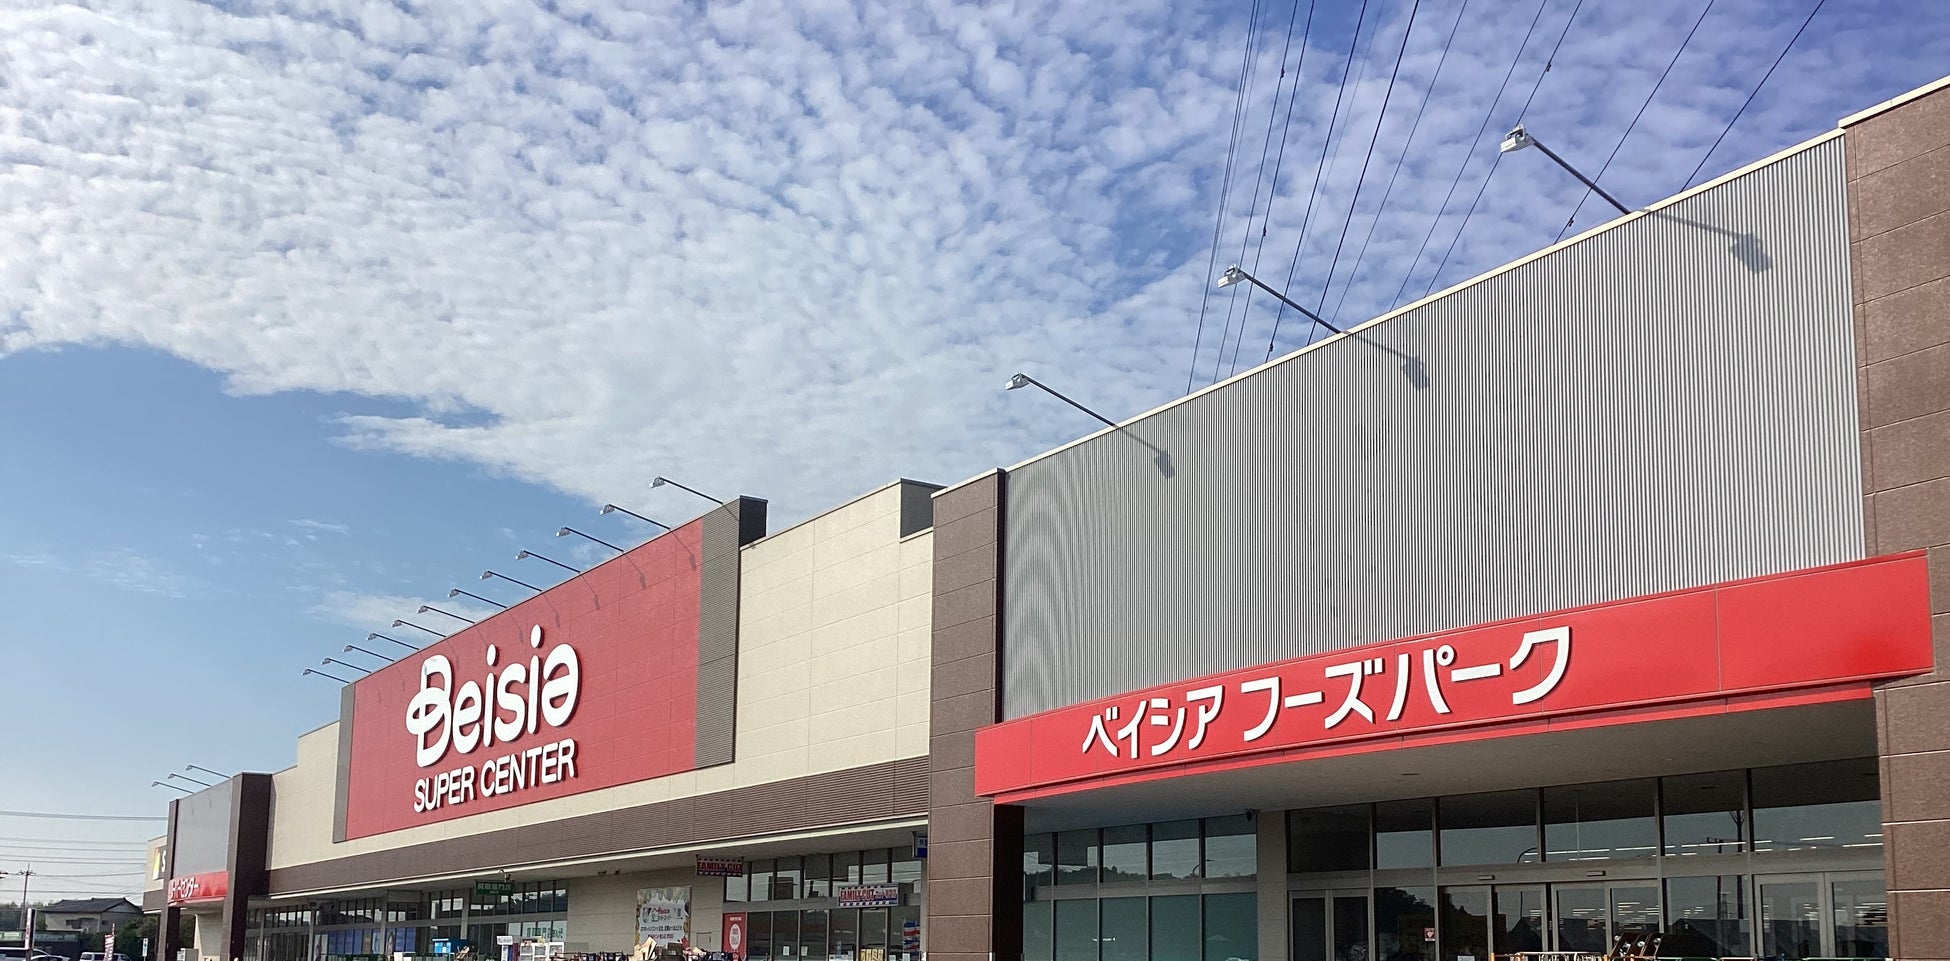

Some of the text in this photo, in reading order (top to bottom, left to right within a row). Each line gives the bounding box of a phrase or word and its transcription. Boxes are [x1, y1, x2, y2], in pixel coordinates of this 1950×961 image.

[406, 624, 579, 767] Beisia
[1082, 626, 1571, 759] ベイシア フーズパーク
[413, 738, 576, 813] SUPER CENTER
